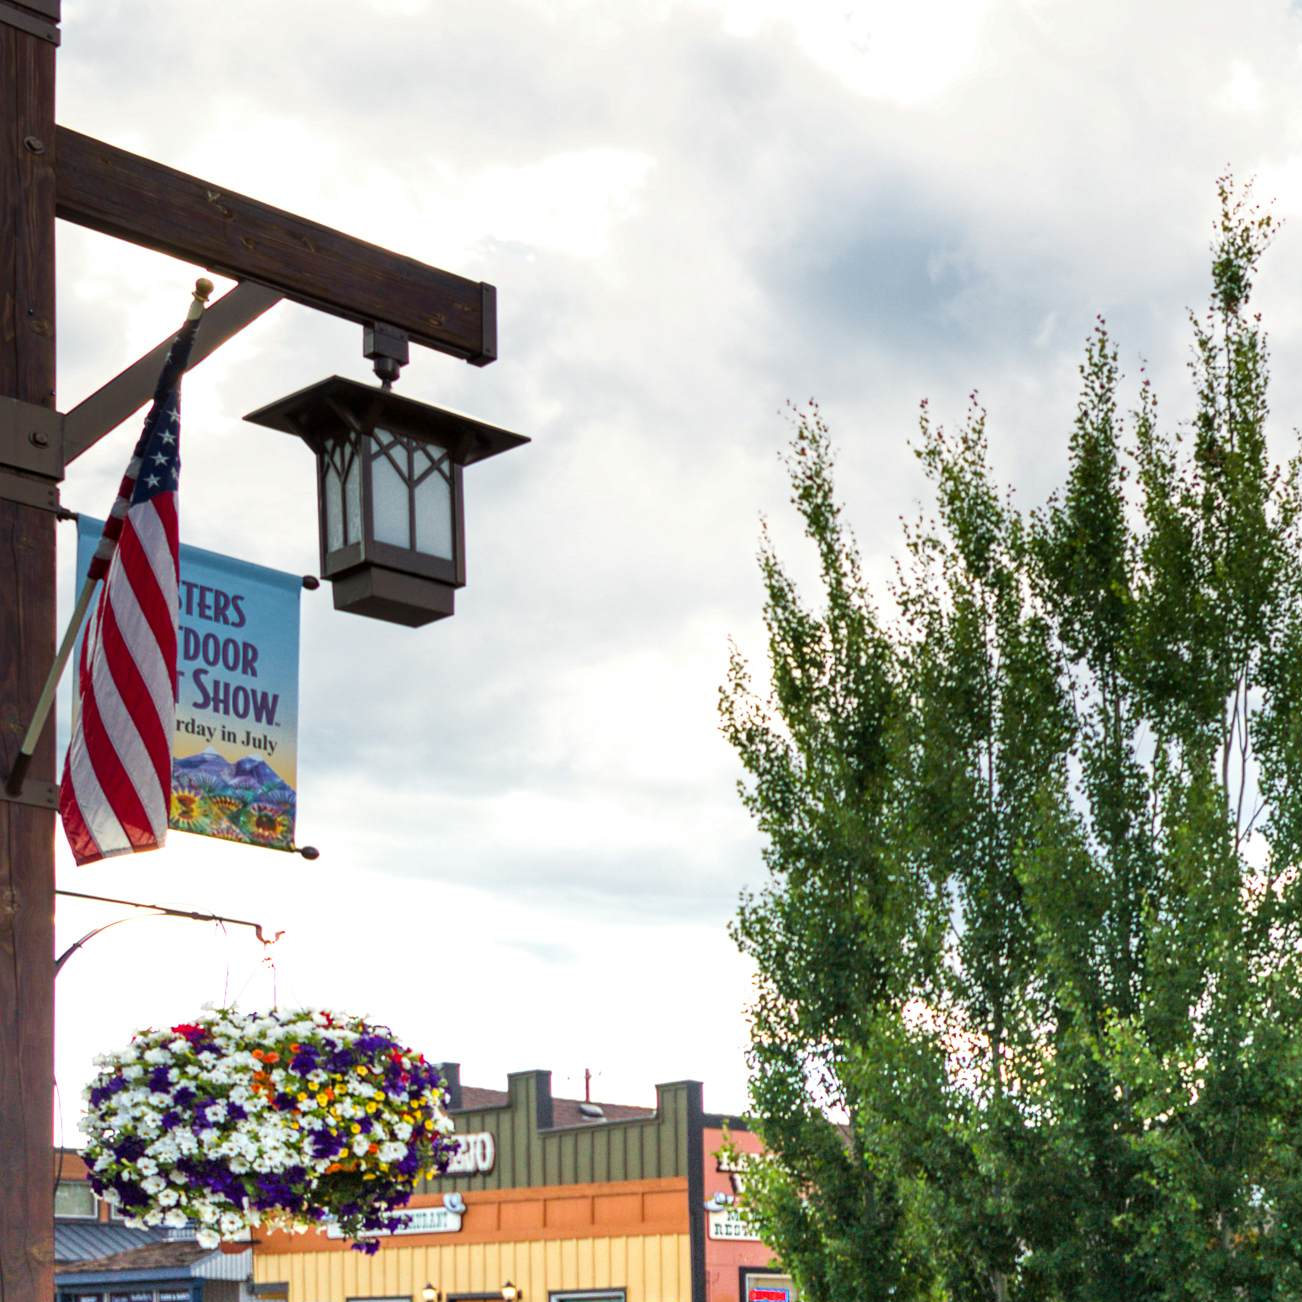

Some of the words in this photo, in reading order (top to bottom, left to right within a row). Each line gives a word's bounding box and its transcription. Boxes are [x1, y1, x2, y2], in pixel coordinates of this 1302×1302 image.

[178, 580, 246, 628] TERS
[192, 668, 280, 727] SHOW
[221, 725, 237, 744] in
[241, 730, 278, 756] July
